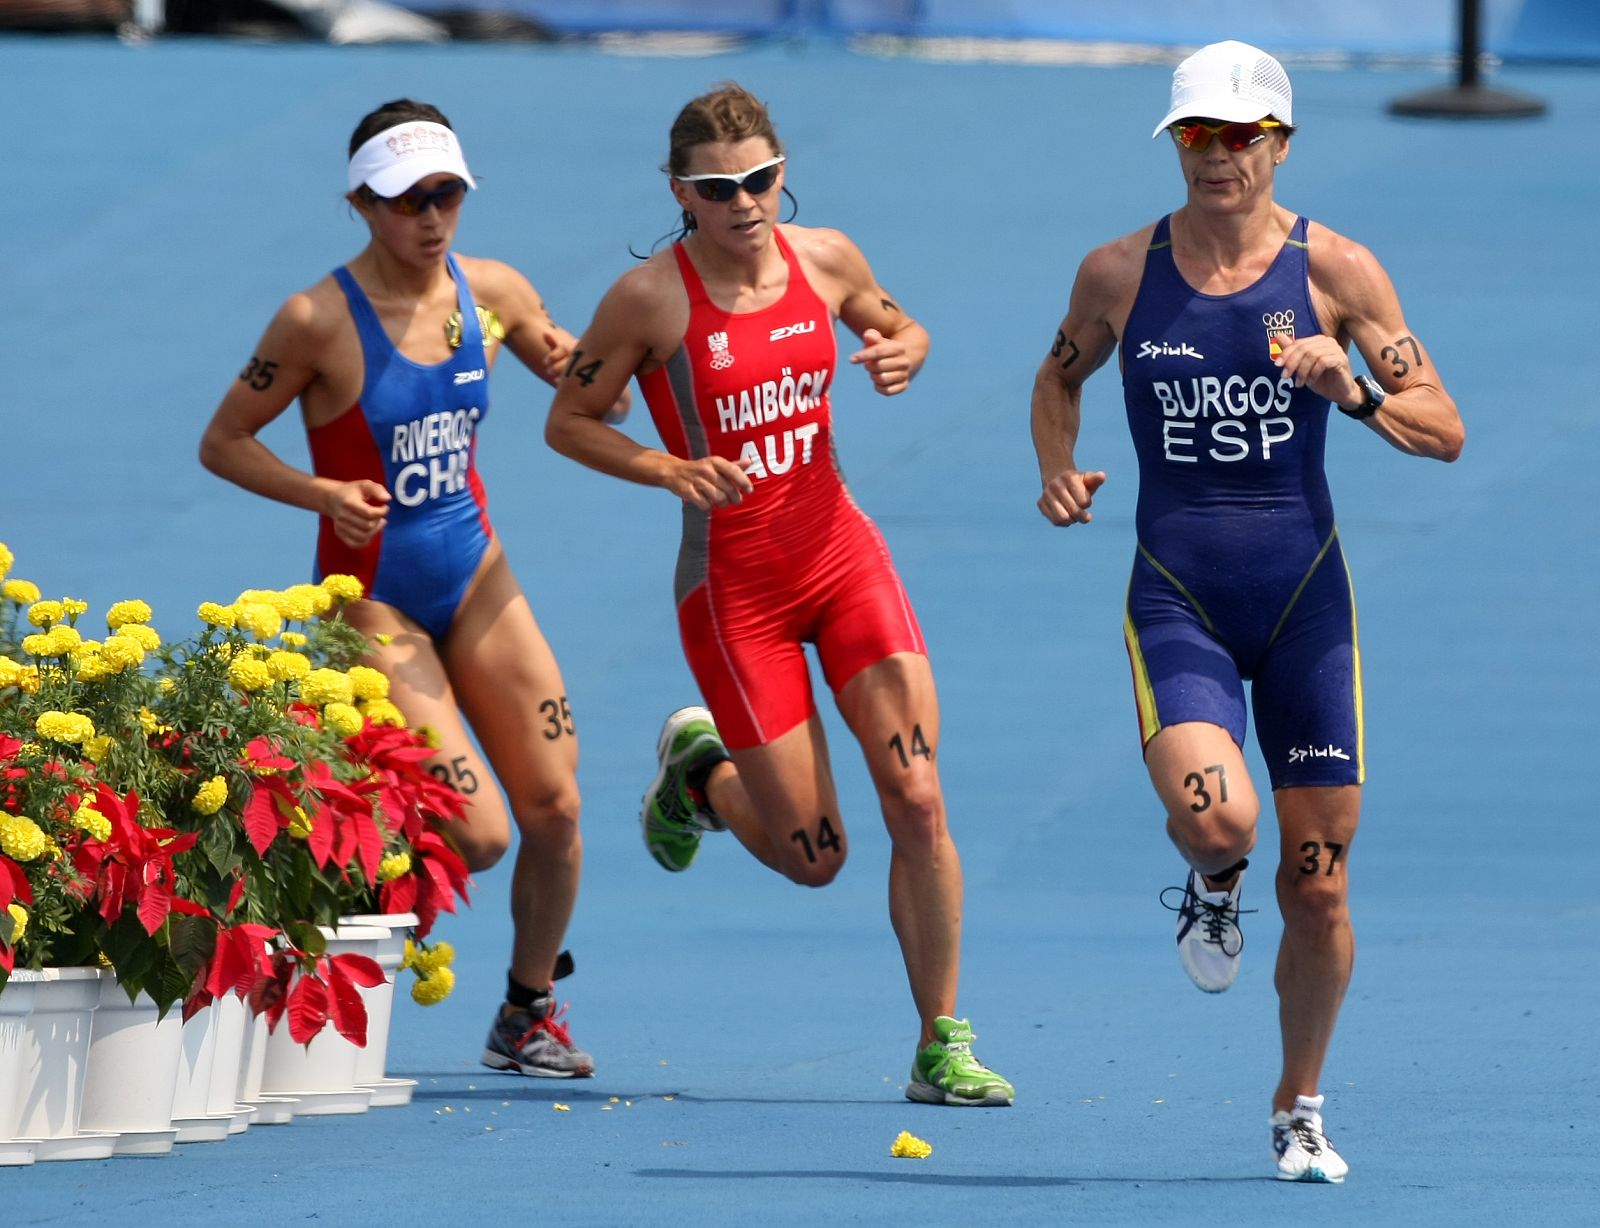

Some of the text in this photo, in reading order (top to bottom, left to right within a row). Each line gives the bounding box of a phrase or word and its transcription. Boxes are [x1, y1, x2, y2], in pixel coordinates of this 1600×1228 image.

[769, 320, 816, 341] 2XU
[1051, 328, 1080, 369] 37
[1137, 341, 1204, 360] Spiuk
[240, 356, 279, 391] 35
[565, 350, 604, 388] 14
[1381, 336, 1423, 378] 37
[716, 367, 829, 434] HAIBÖCK
[1152, 375, 1295, 419] BURGOS
[740, 423, 819, 479] AUT
[1163, 417, 1296, 463] ESP
[539, 697, 575, 740] 35
[888, 724, 931, 767] 14
[1184, 765, 1229, 812] 37
[791, 816, 840, 863] 14
[1300, 841, 1343, 876] 37
